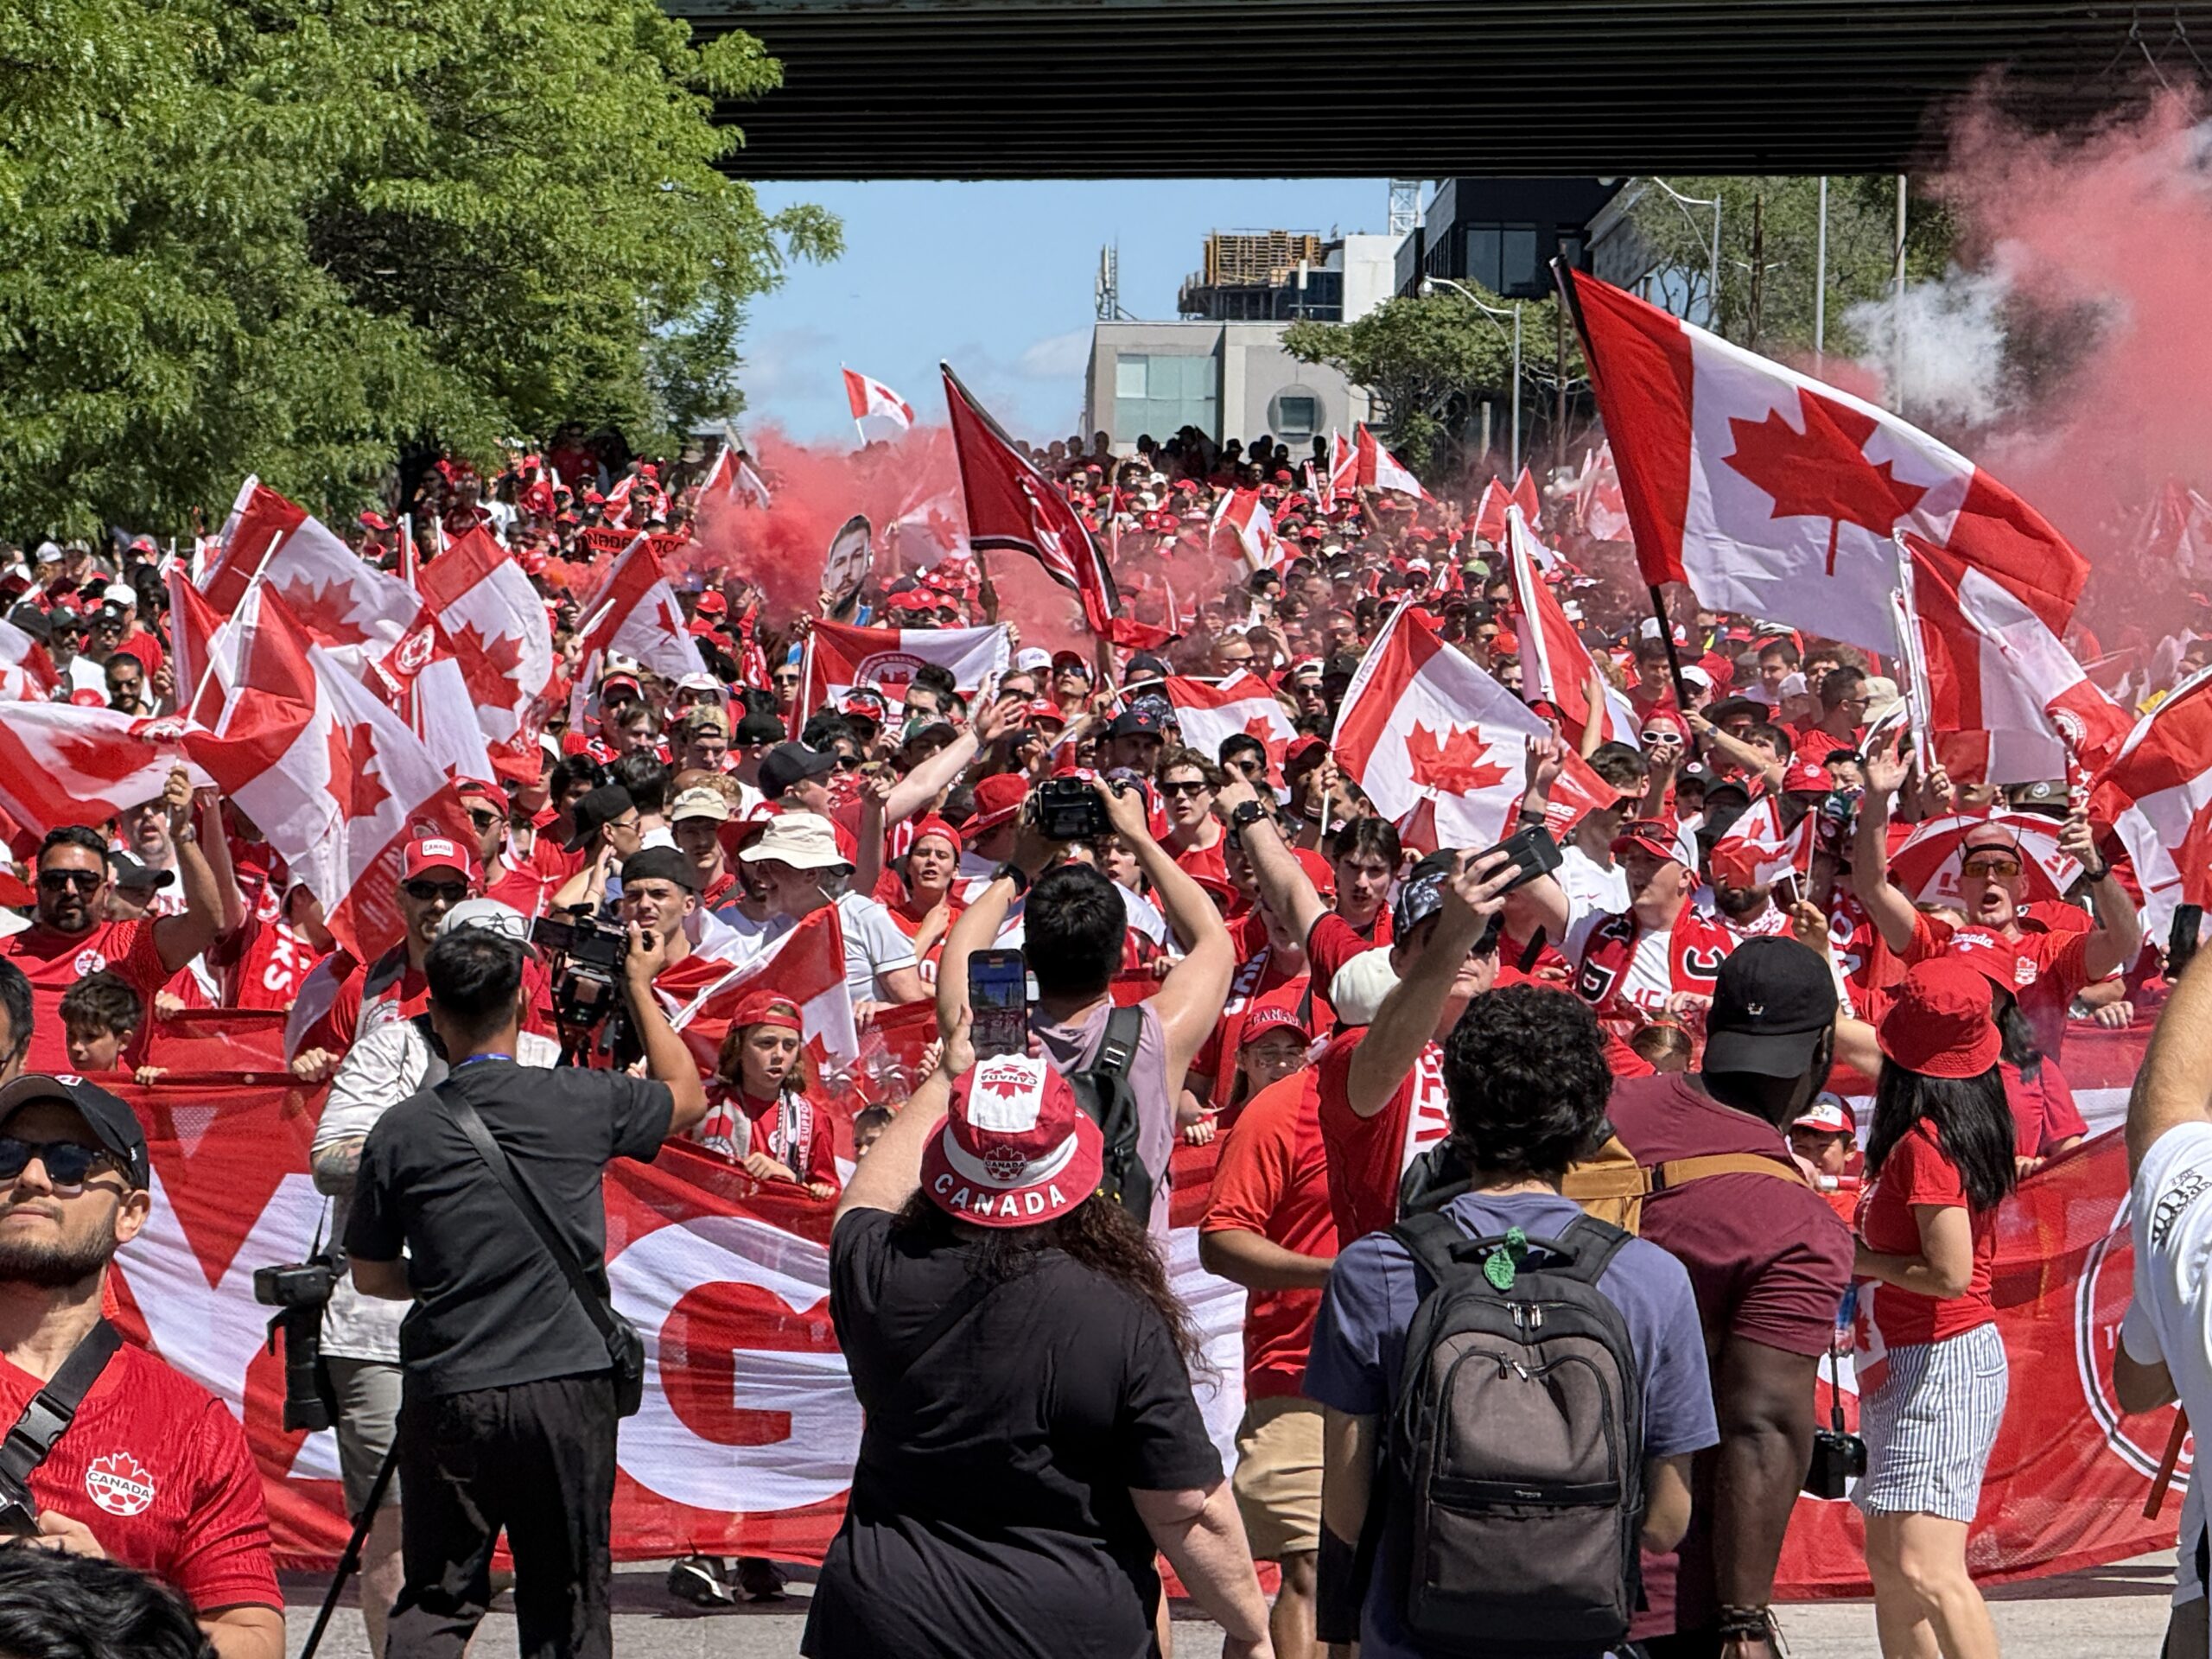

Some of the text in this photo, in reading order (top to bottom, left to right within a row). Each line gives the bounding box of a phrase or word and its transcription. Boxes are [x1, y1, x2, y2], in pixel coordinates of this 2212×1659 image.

[423, 844, 452, 853] CANADA
[981, 1073, 1039, 1085] CANADA
[983, 1160, 1026, 1168] CANADA
[933, 1173, 1066, 1217] CANADA
[87, 1472, 150, 1499] CANADA
